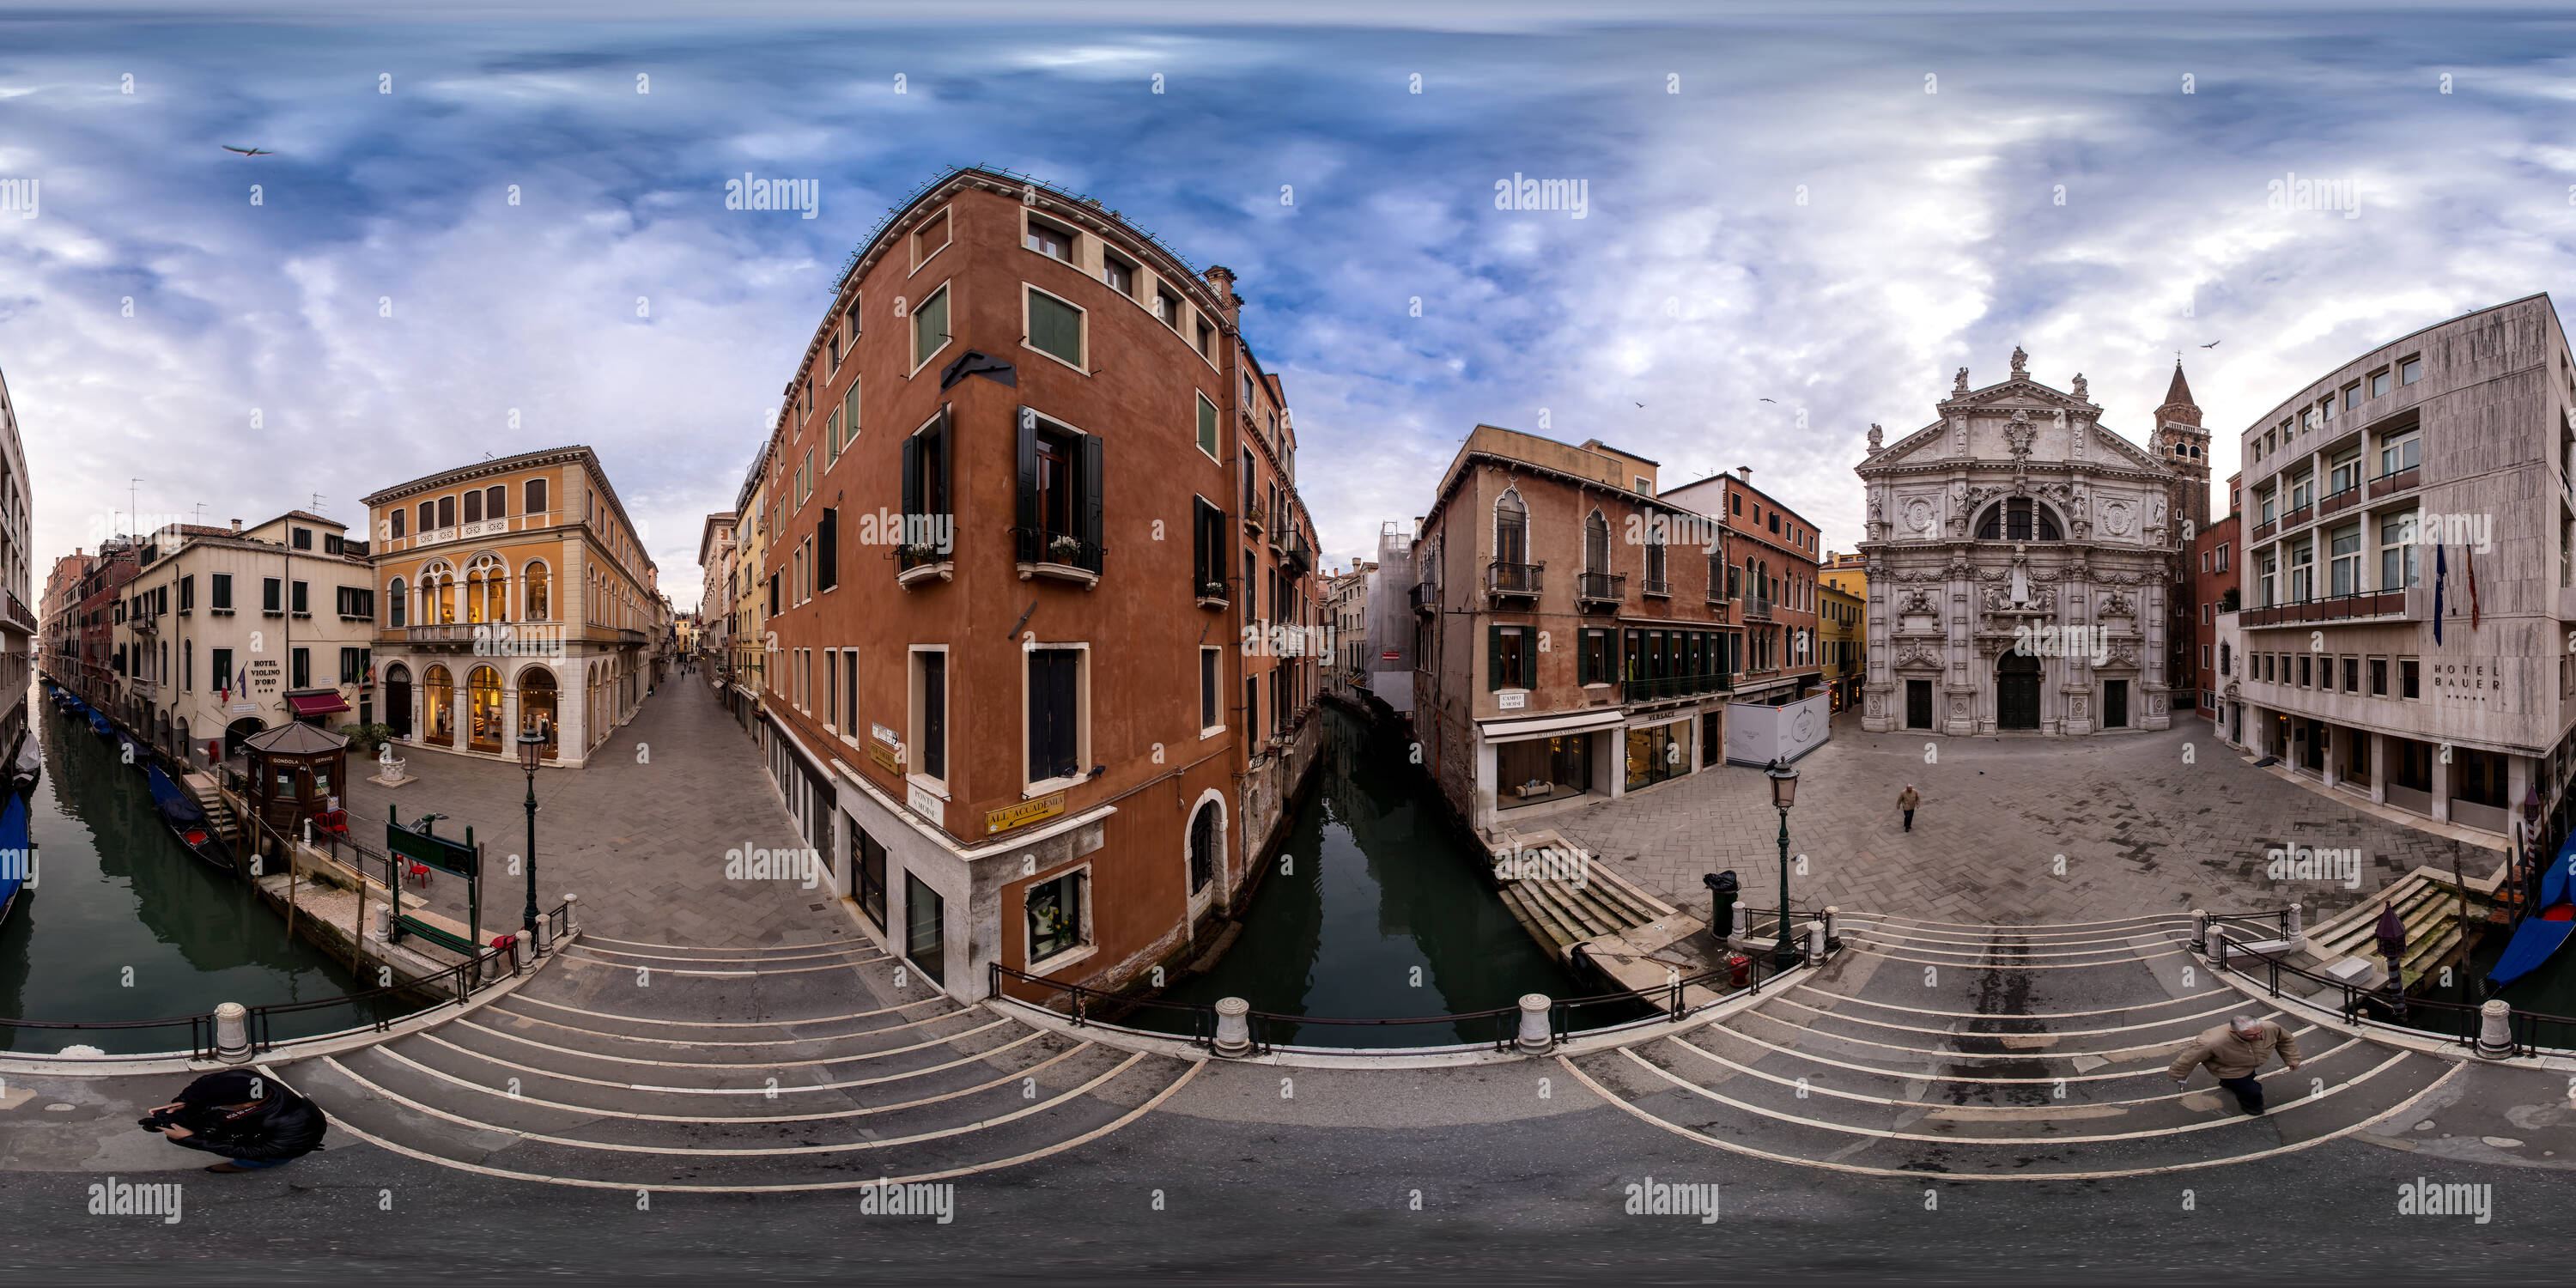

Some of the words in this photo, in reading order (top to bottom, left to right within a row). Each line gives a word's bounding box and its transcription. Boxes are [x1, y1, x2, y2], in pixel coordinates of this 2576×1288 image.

[2434, 664, 2500, 677] HOTEL
[2434, 677, 2500, 690] BAUER
[1649, 711, 1675, 721] VERSACE
[1537, 730, 1563, 738] BOTTEGA
[1564, 727, 1584, 736] VENETA
[914, 790, 934, 807] PONTE
